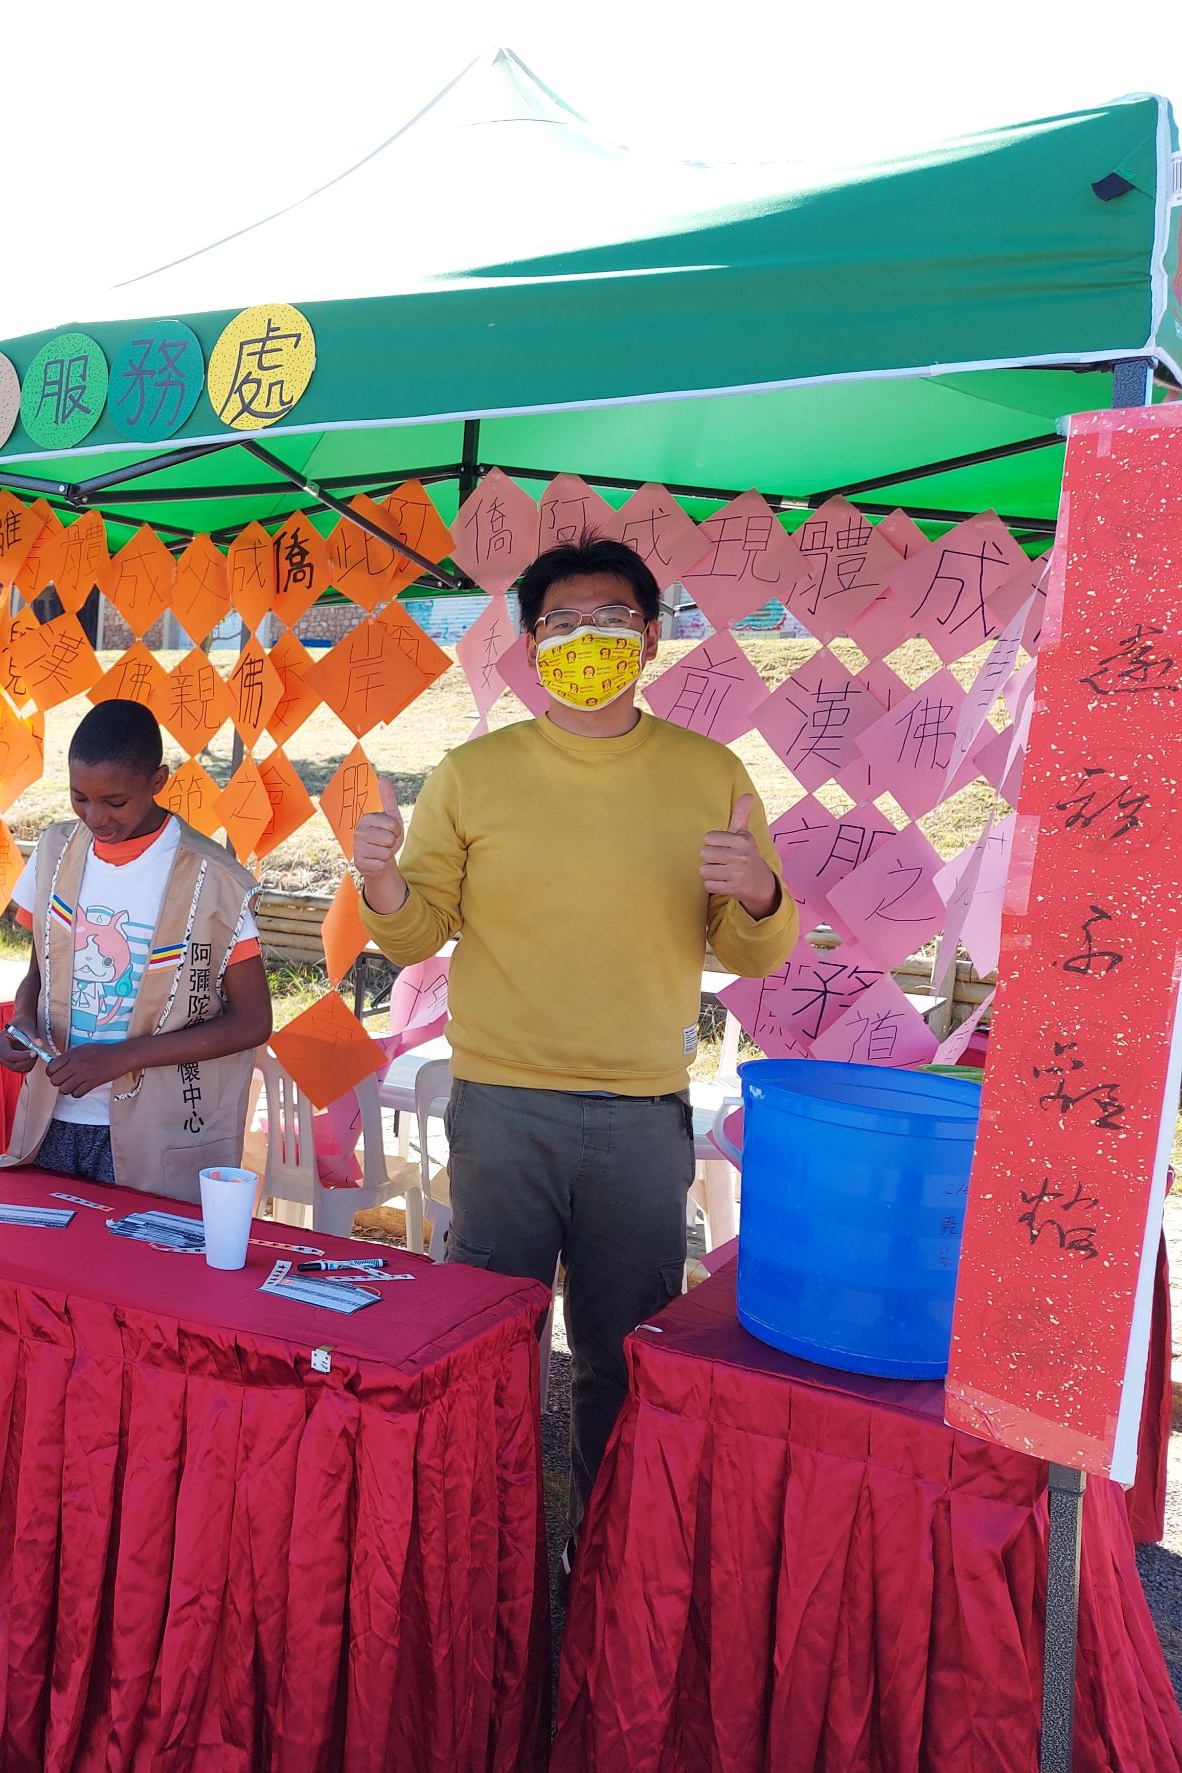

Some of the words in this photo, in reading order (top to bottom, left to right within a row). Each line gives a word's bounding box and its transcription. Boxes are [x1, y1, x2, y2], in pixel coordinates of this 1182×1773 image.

[272, 526, 314, 594] 僑
[465, 497, 513, 564] 僑
[682, 514, 781, 584] 現
[910, 541, 1010, 638] 成
[233, 652, 265, 729] 佛
[785, 676, 863, 771] 漢
[861, 858, 937, 921] 之
[177, 941, 212, 1134] 阿彌陀懷中心
